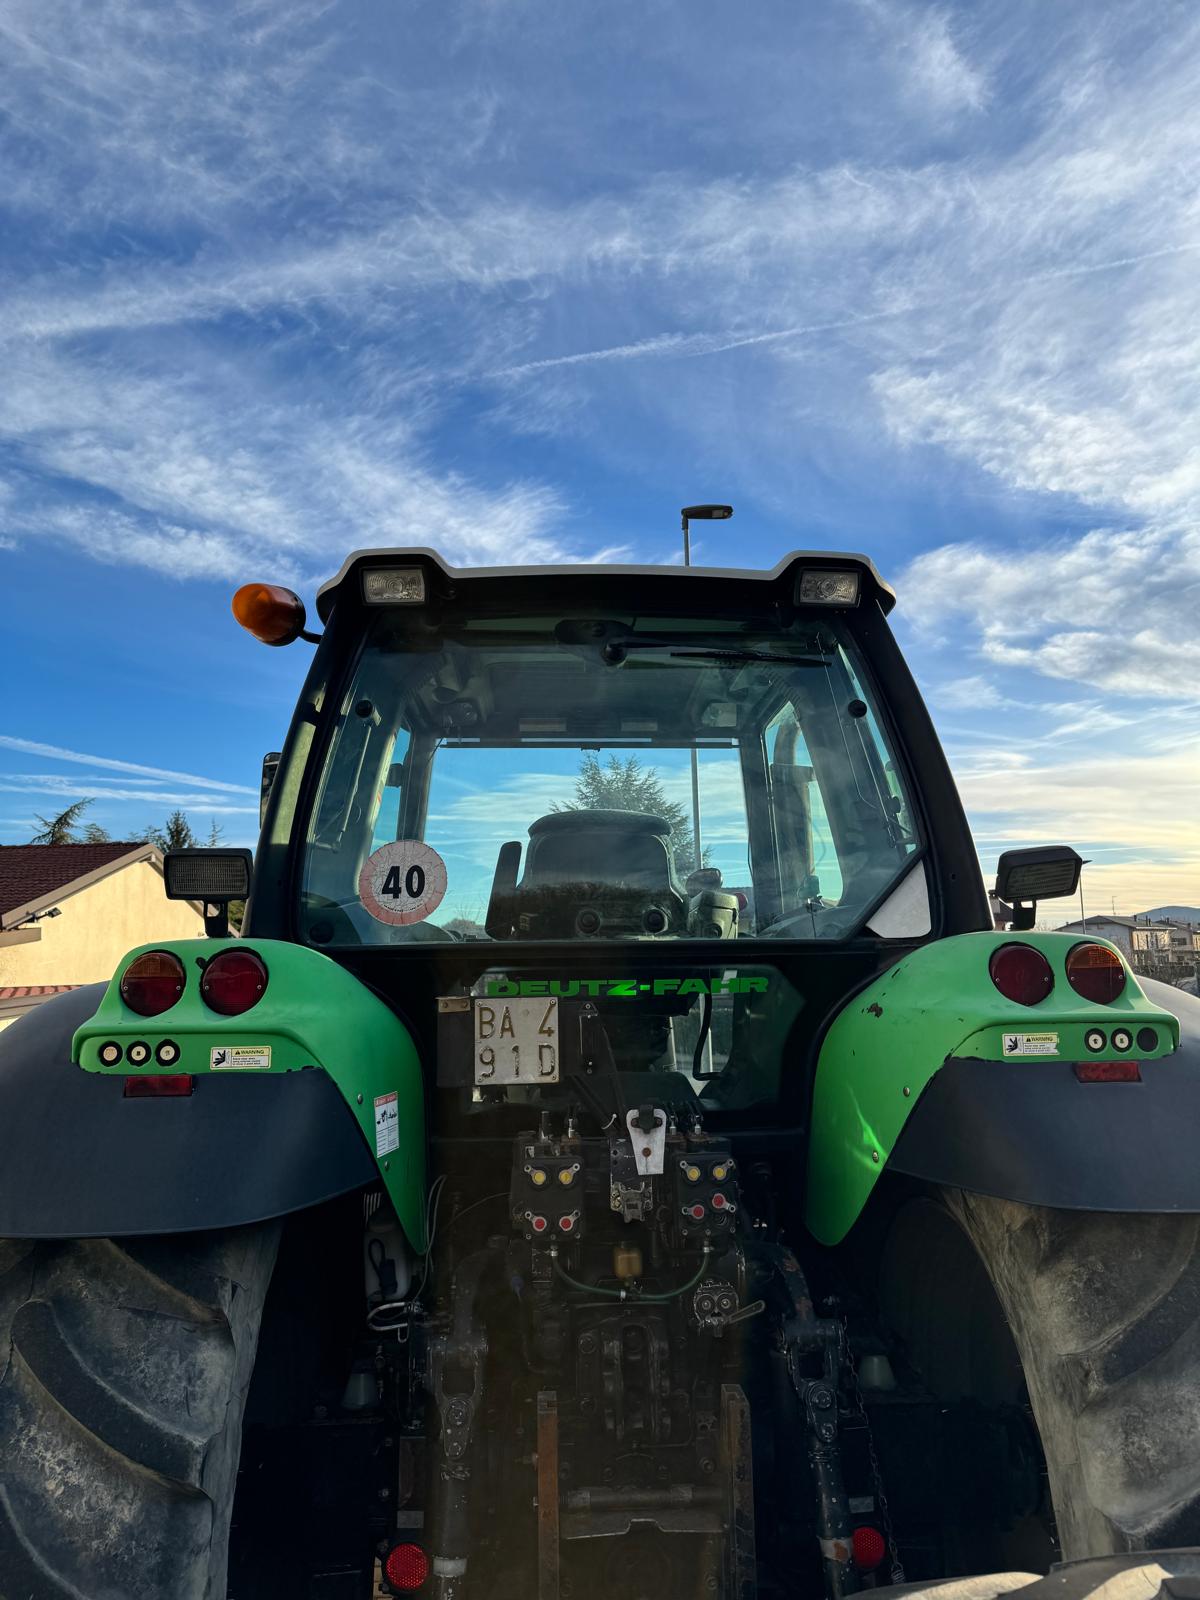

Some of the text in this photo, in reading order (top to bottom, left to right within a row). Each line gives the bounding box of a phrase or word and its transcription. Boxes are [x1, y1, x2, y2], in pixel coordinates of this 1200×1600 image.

[381, 865, 426, 899] 40
[487, 977, 769, 996] DEUTZ-FAHR
[479, 1002, 555, 1039] BA 4
